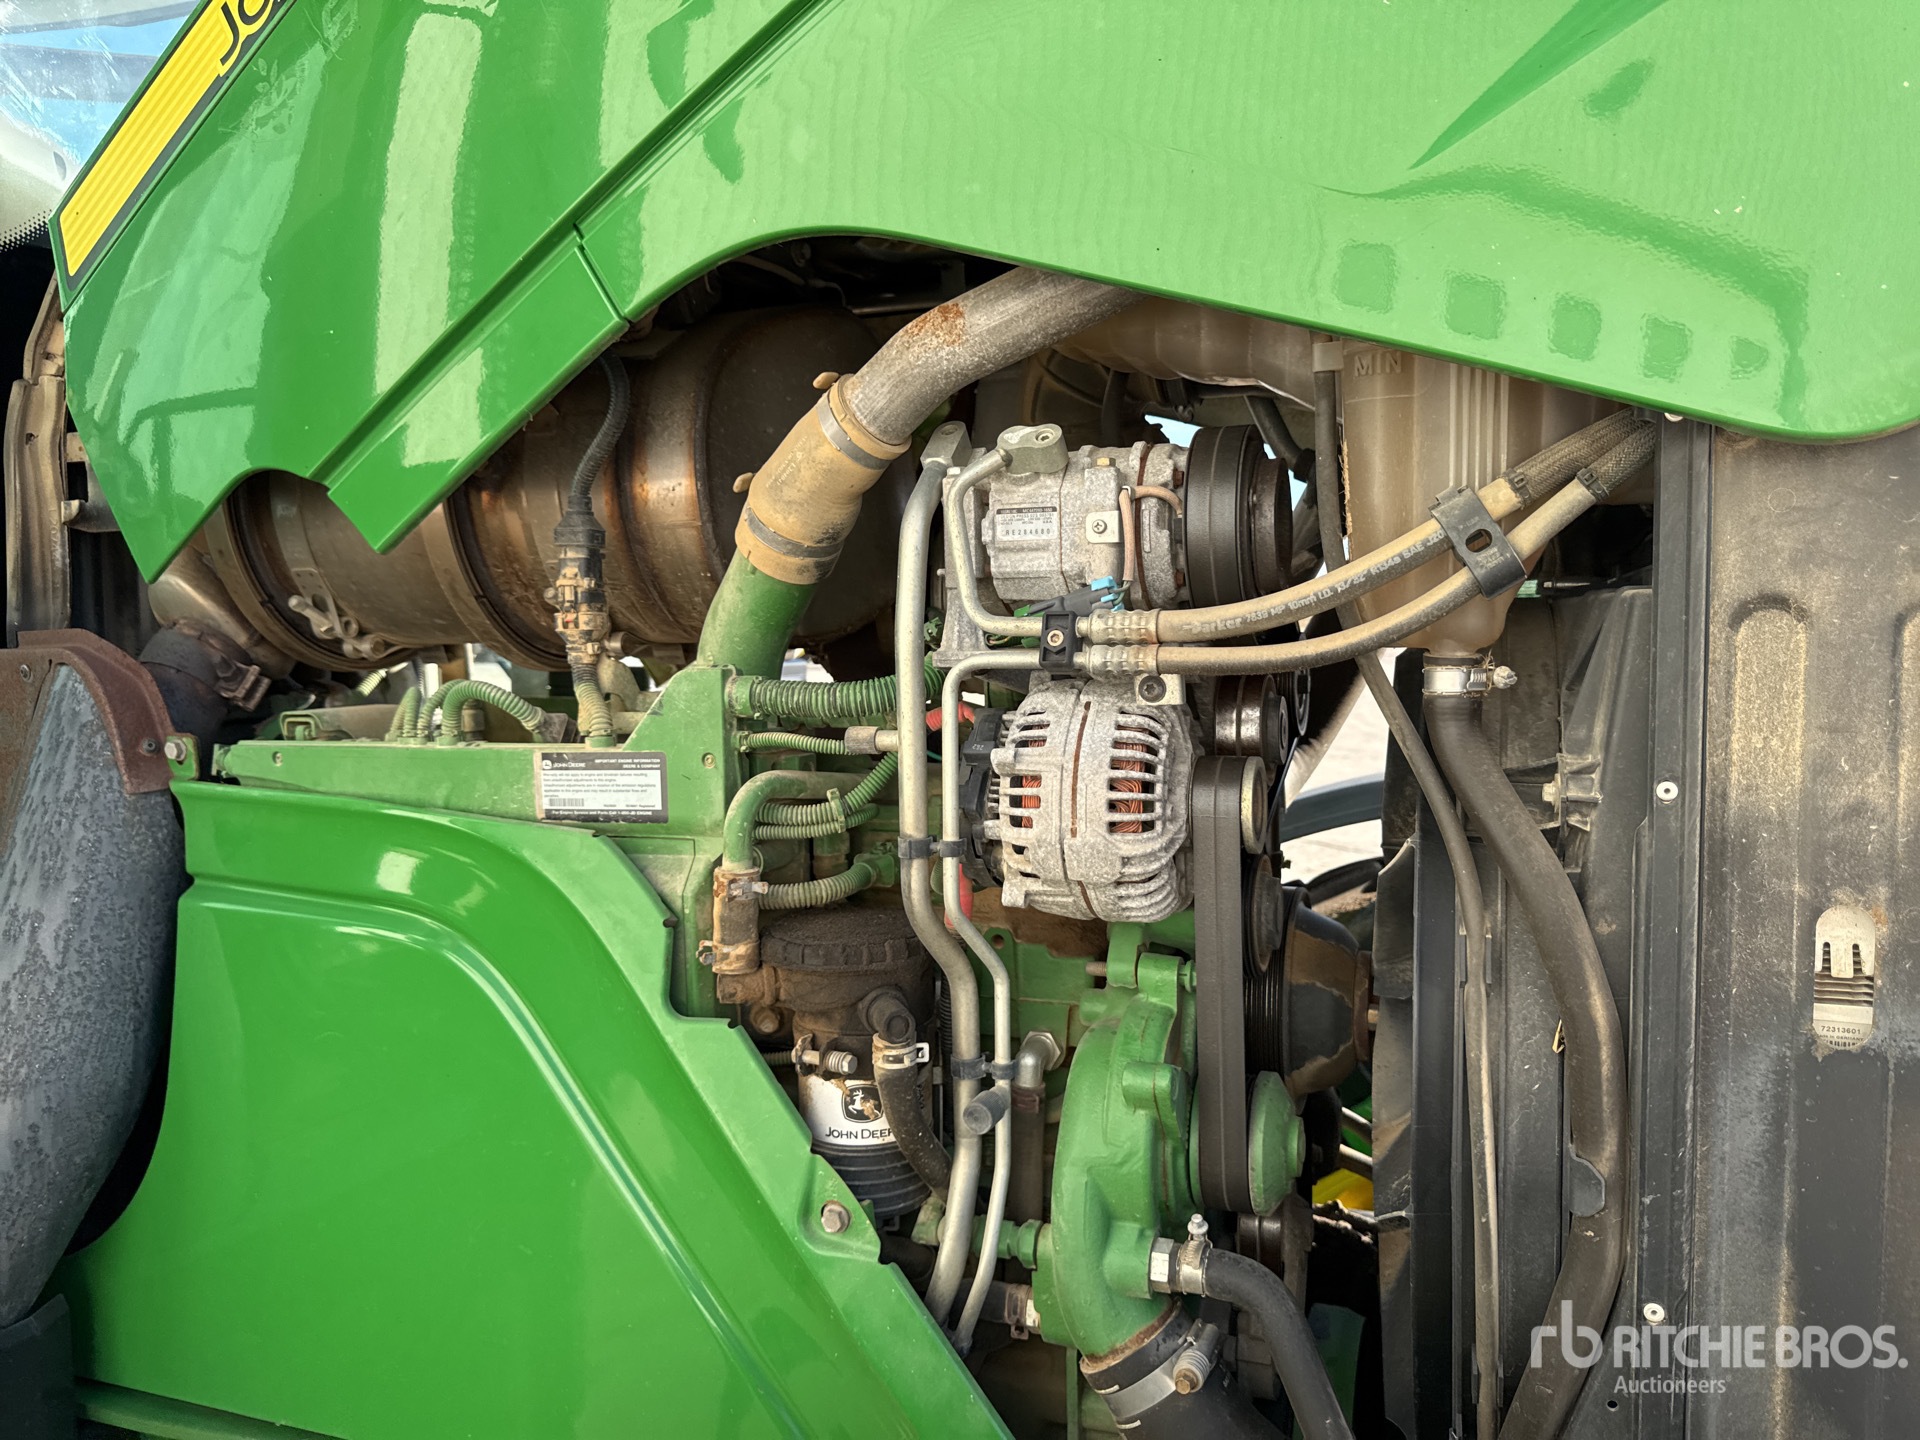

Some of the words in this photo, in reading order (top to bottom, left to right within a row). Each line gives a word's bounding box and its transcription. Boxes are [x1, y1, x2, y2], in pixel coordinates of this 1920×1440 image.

[1354, 351, 1402, 377] MIN
[1270, 604, 1287, 617] MP
[1288, 592, 1318, 610] 10mm
[1402, 541, 1425, 559] SAE
[1426, 530, 1447, 546] J20
[1821, 1025, 1861, 1035] 72313601
[825, 1126, 858, 1140] JOHN
